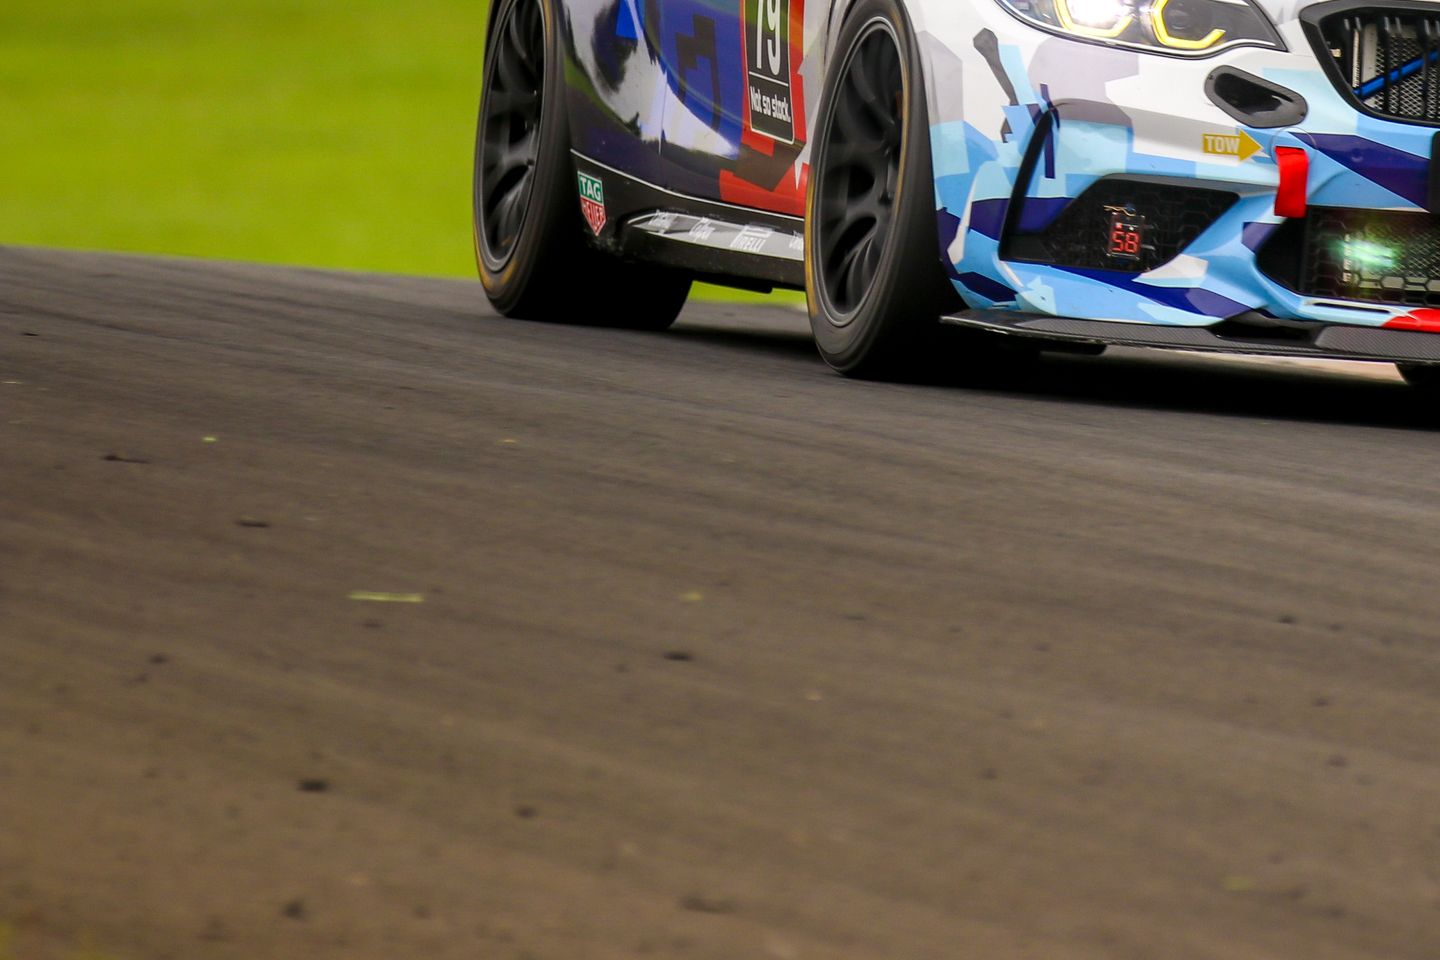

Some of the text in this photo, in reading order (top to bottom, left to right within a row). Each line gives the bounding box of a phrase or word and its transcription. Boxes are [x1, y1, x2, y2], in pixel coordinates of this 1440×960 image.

[750, 86, 792, 123] Not so stock.
[1206, 135, 1241, 154] TOW
[580, 176, 602, 201] TAG
[1110, 230, 1140, 254] 58
